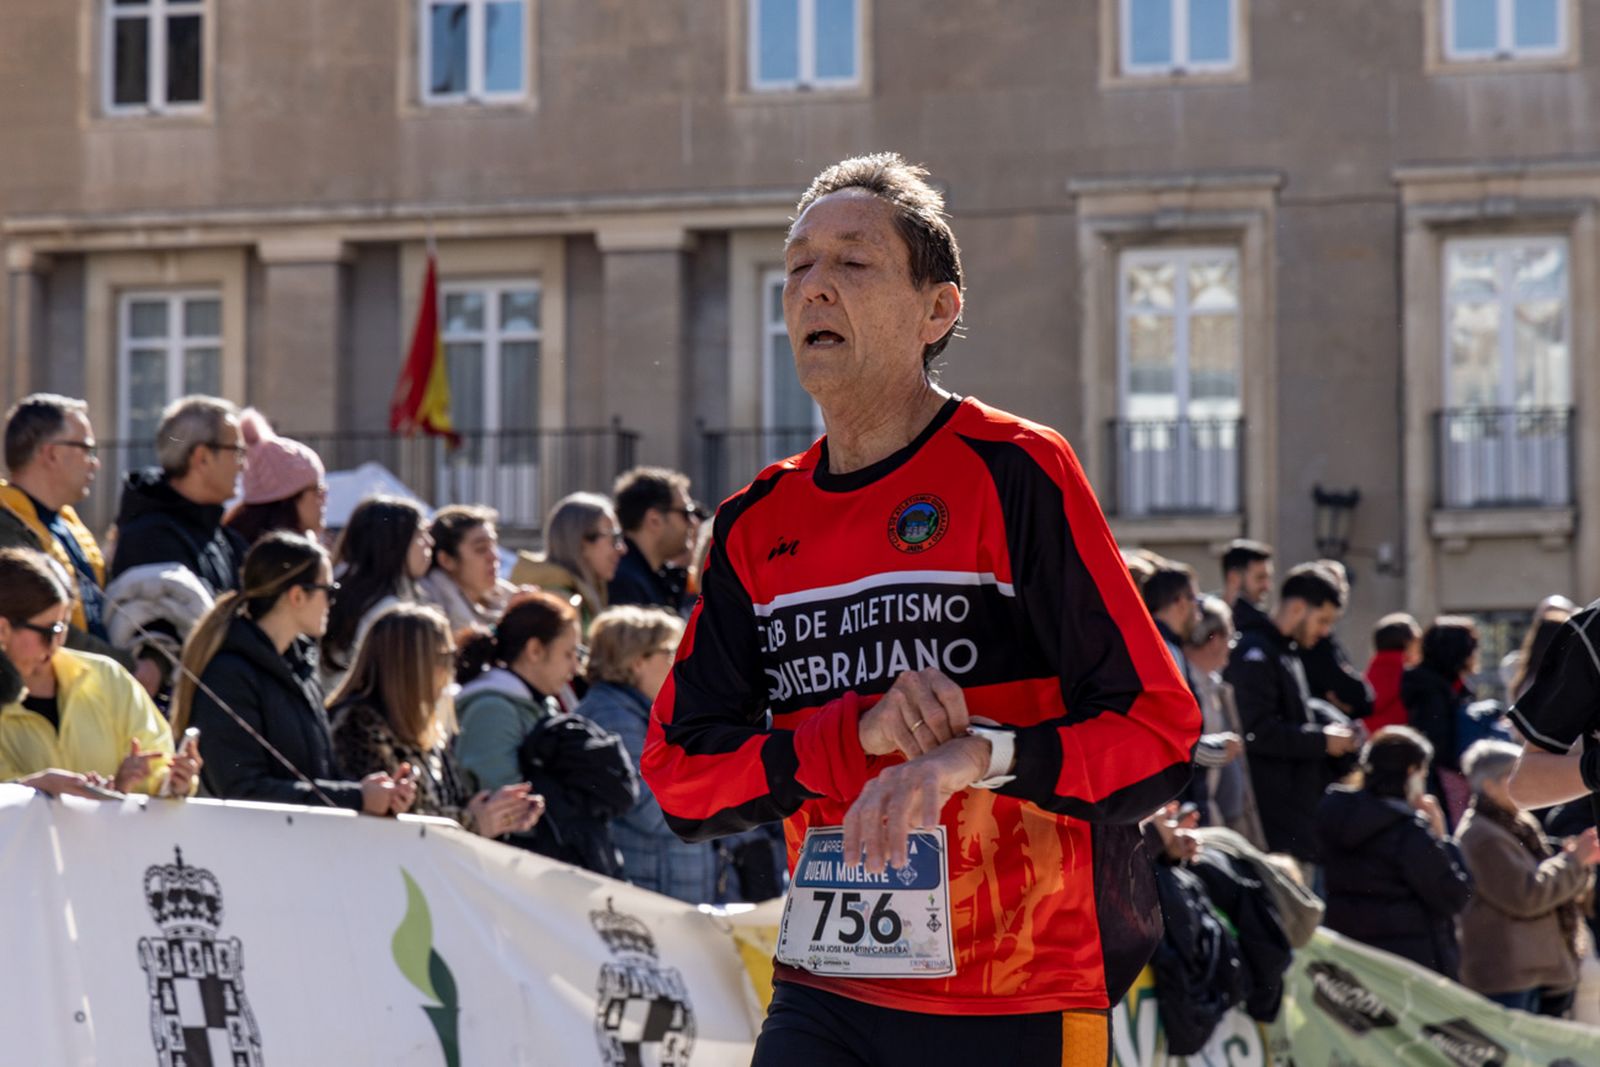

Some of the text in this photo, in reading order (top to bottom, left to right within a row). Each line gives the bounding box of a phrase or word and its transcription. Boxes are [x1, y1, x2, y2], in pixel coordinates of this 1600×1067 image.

[758, 593, 970, 653] LB DE ATLETISMO
[804, 860, 833, 881] BUENA
[811, 891, 902, 944] 756
[808, 944, 908, 954] JUAN JOSE MARTIN CABRERA
